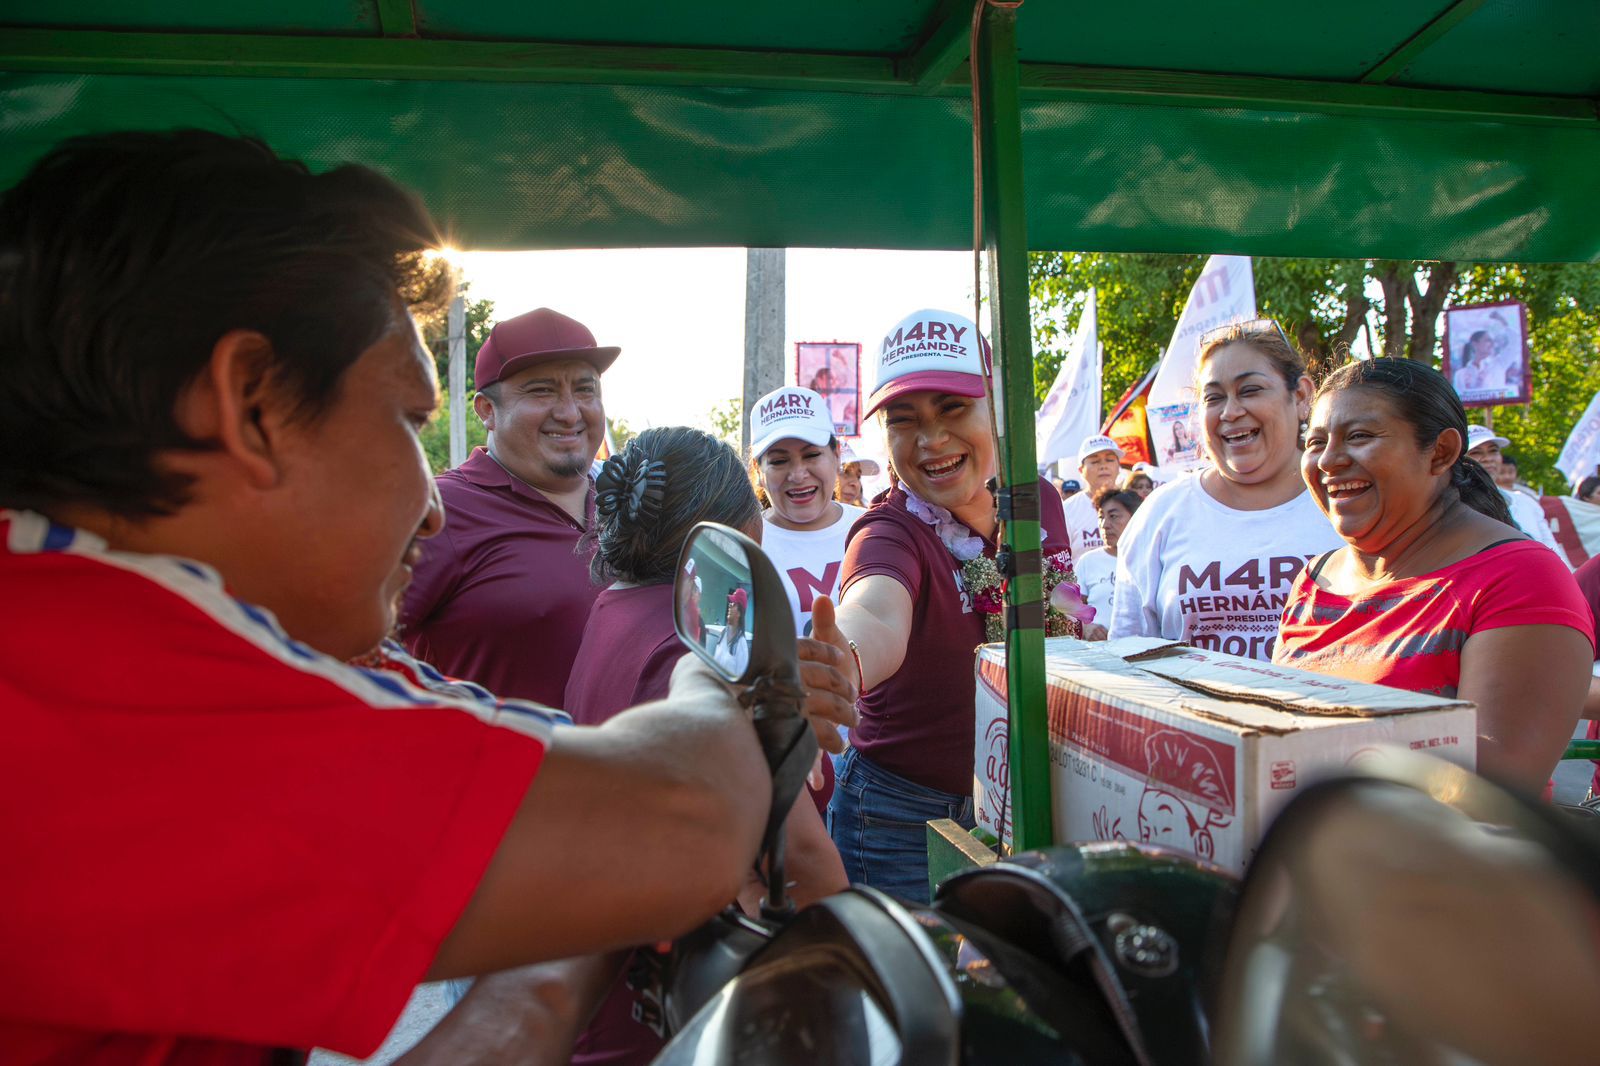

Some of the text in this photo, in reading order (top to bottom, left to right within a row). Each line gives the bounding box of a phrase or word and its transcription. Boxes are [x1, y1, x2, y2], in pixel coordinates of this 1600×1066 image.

[882, 321, 967, 355] M4RY
[881, 340, 967, 366] HERNÁNDEZ
[901, 352, 941, 361] PRESIDENTA
[760, 394, 812, 418] M4RY
[760, 408, 815, 425] HERNÁNDEZ
[1178, 554, 1317, 596] M4R
